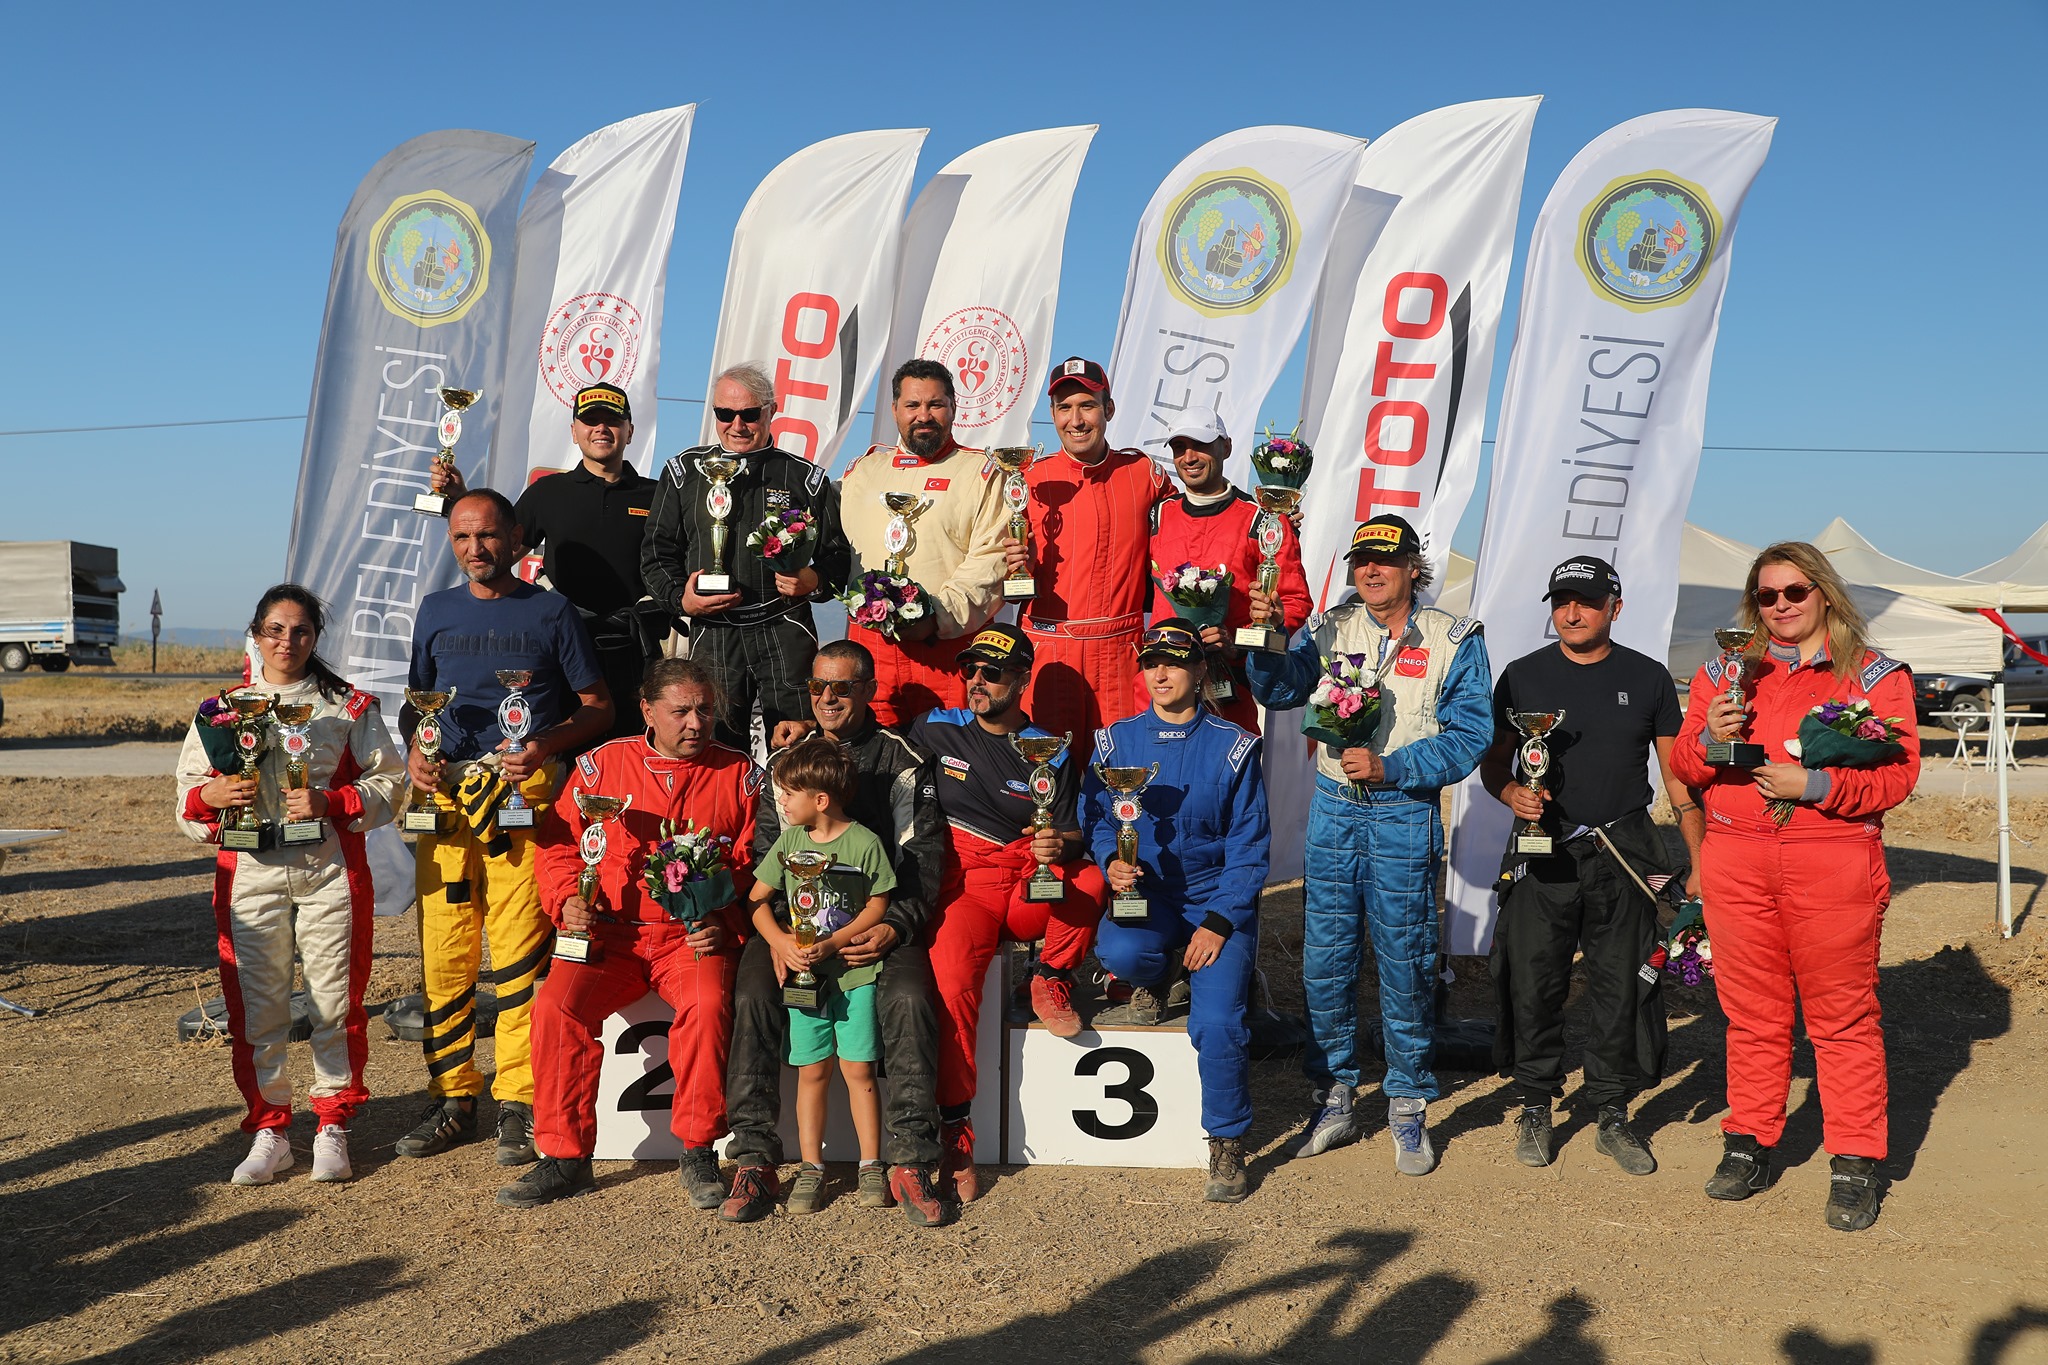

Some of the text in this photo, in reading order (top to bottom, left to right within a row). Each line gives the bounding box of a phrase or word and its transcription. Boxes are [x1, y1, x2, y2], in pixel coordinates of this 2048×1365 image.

[589, 314, 620, 330] GENÇLİK
[620, 326, 630, 337] VE
[967, 329, 997, 343] GENÇLİK
[939, 332, 967, 365] MHURİYETİ
[995, 340, 1004, 351] VE
[999, 350, 1007, 371] SPOR
[770, 291, 840, 464] OTO
[1354, 271, 1449, 522] TOTO
[1355, 527, 1398, 541] PIRELLI
[1555, 562, 1597, 575] WRC
[1398, 657, 1427, 668] ENEOS
[1864, 660, 1892, 681] sparco
[1158, 731, 1187, 739] sparco
[1231, 737, 1251, 761] sparco
[615, 1020, 673, 1112] 2
[1072, 1046, 1159, 1141] 3
